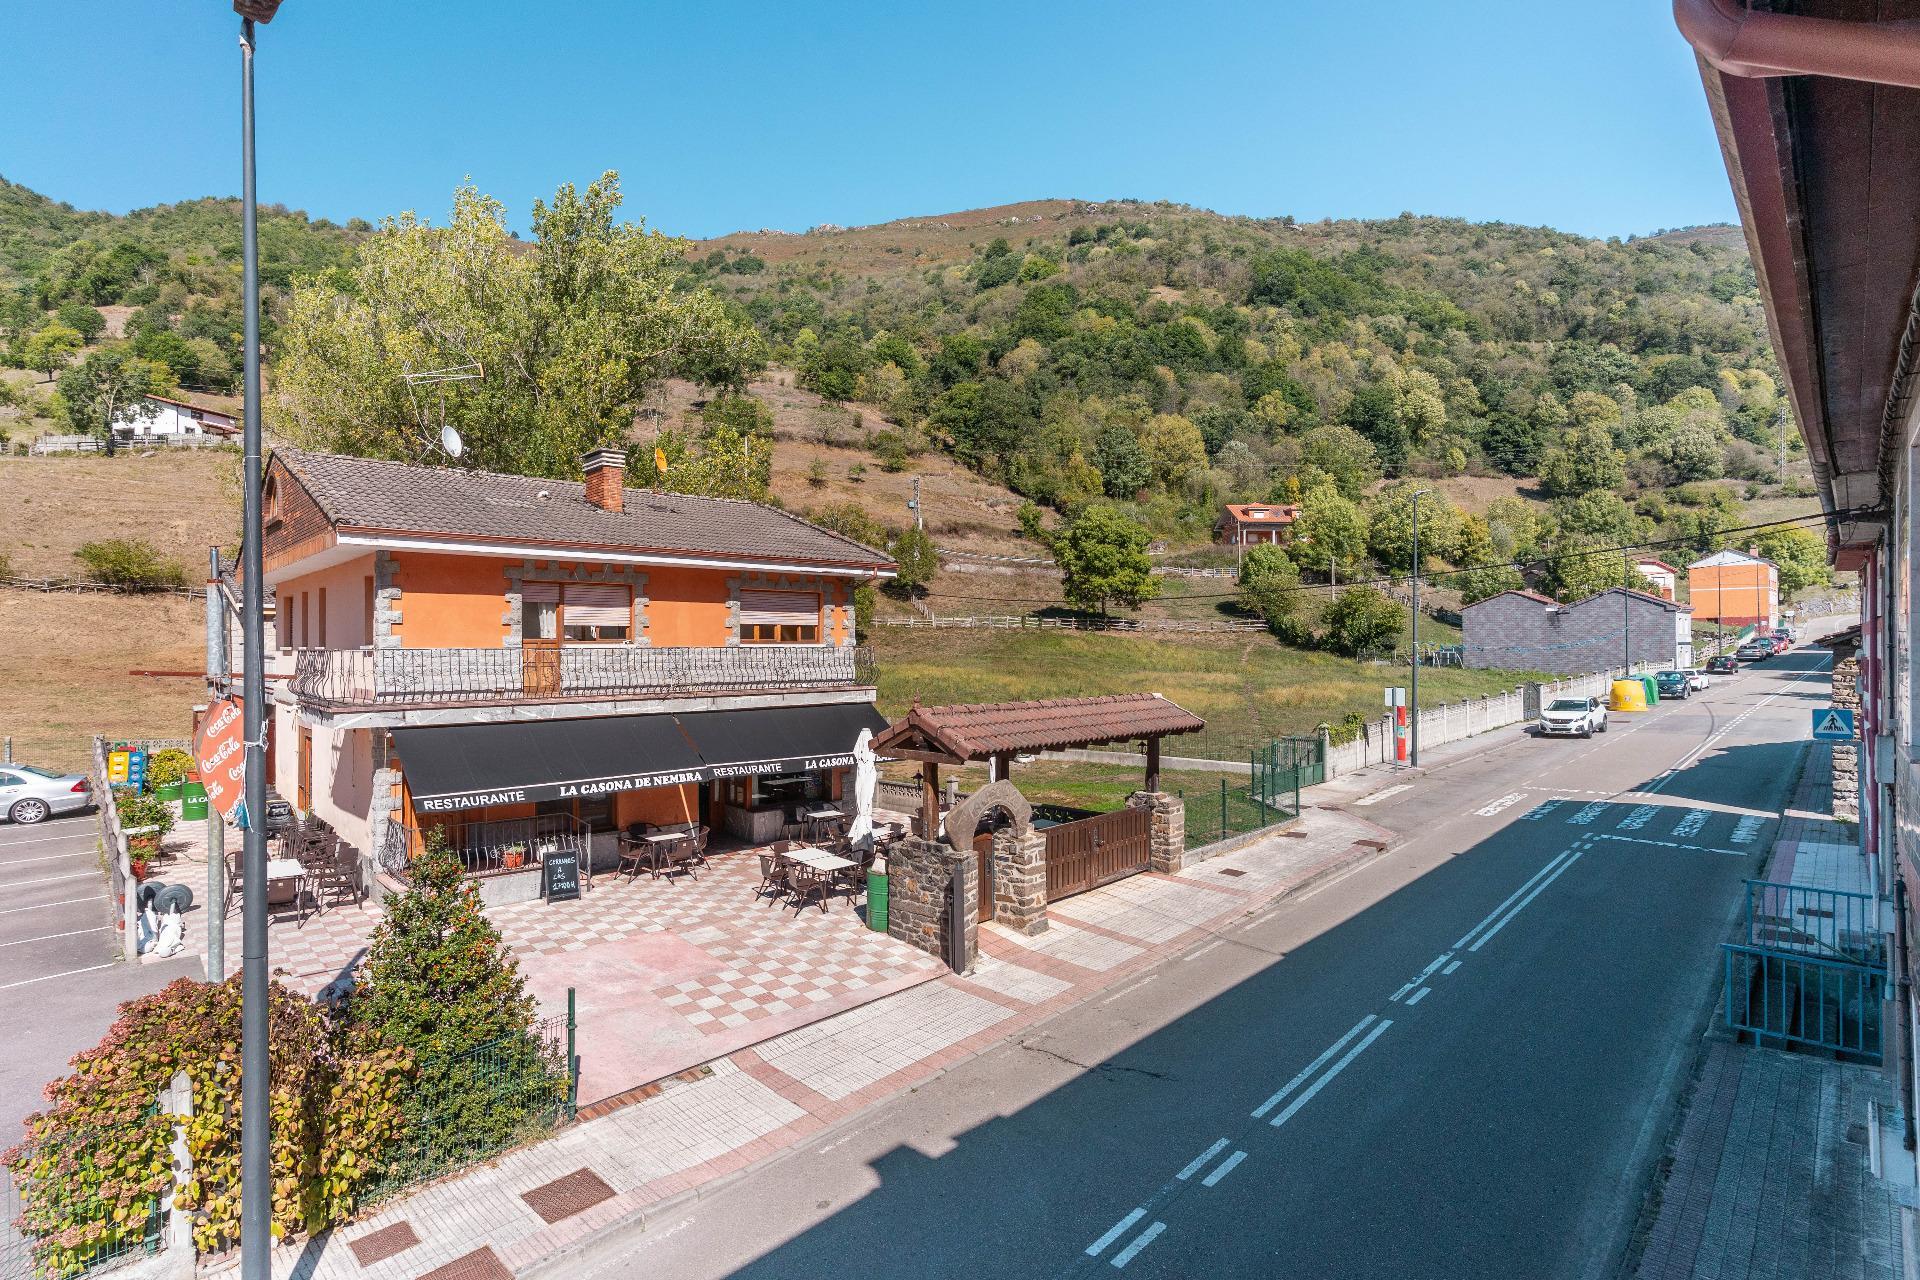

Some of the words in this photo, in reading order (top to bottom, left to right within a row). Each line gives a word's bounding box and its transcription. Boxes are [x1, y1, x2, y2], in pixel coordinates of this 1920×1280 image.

[713, 763, 782, 777] RESTAURANTE
[805, 760, 817, 769] LA
[819, 757, 854, 768] CASONA
[560, 786, 578, 797] LA
[580, 780, 633, 795] CASONA
[635, 777, 651, 788] DE
[653, 771, 702, 786] NEMBRA
[423, 790, 526, 810] RESTAURANTE
